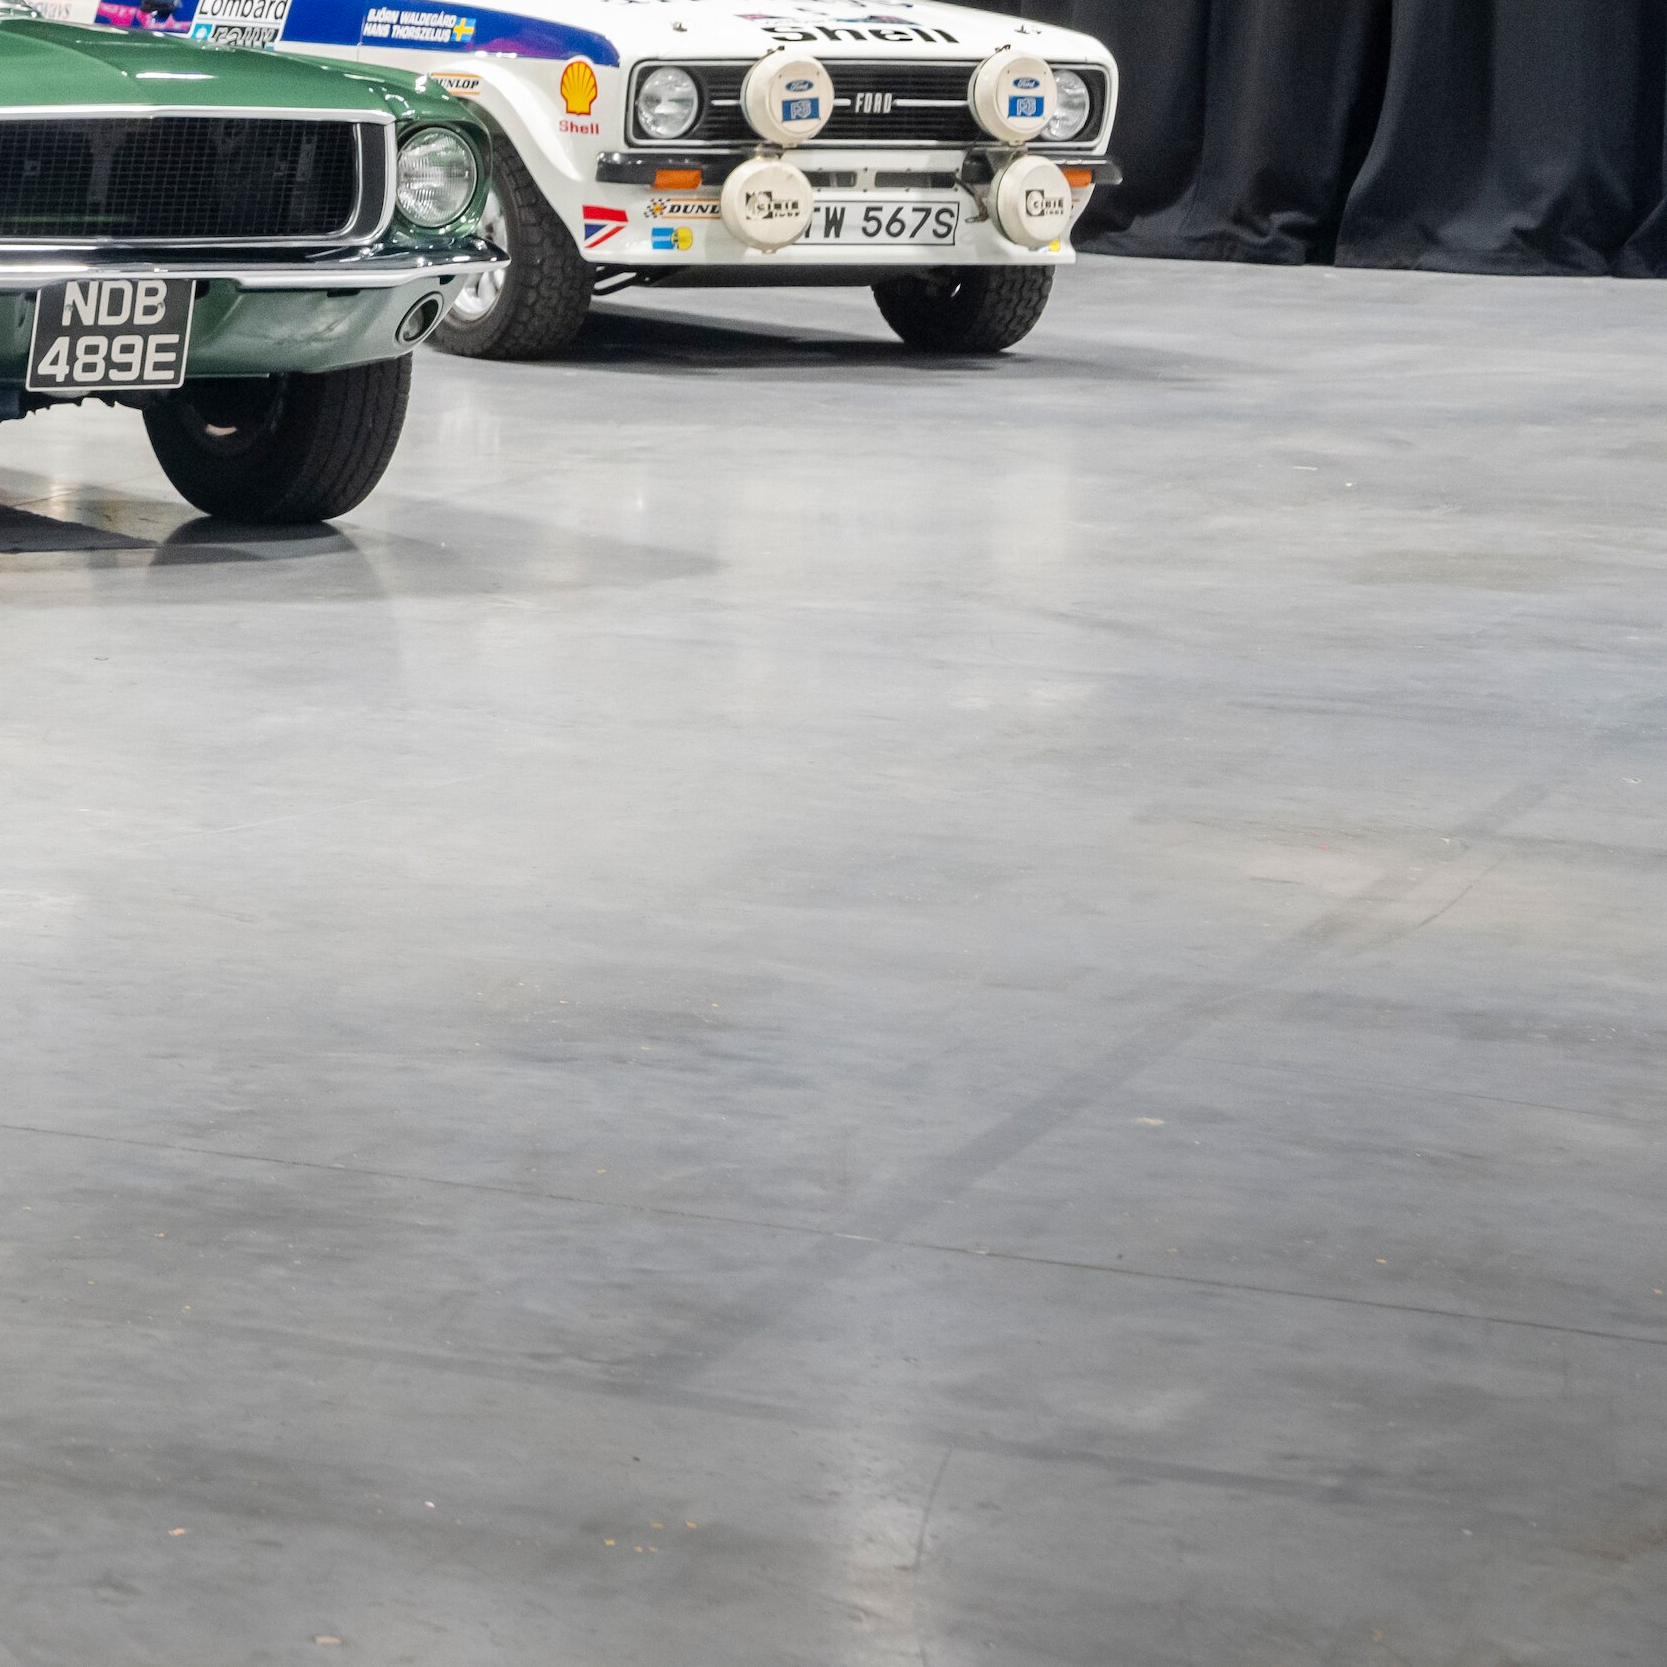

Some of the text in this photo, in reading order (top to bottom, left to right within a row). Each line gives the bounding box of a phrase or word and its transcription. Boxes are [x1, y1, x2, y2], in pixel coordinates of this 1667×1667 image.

[367, 6, 457, 28] BJÖRN WALDEGÅRD
[363, 22, 451, 43] HANS THORSZELIUS
[762, 25, 959, 44] Shell
[433, 78, 479, 90] UNLOP
[788, 80, 813, 92] Ford
[1017, 78, 1037, 89] Ford
[854, 93, 892, 114] FORD
[559, 120, 600, 135] Shell
[668, 204, 721, 215] DUNL
[861, 206, 956, 239] 567S
[62, 280, 167, 326] NDB
[37, 334, 180, 383] 489E
